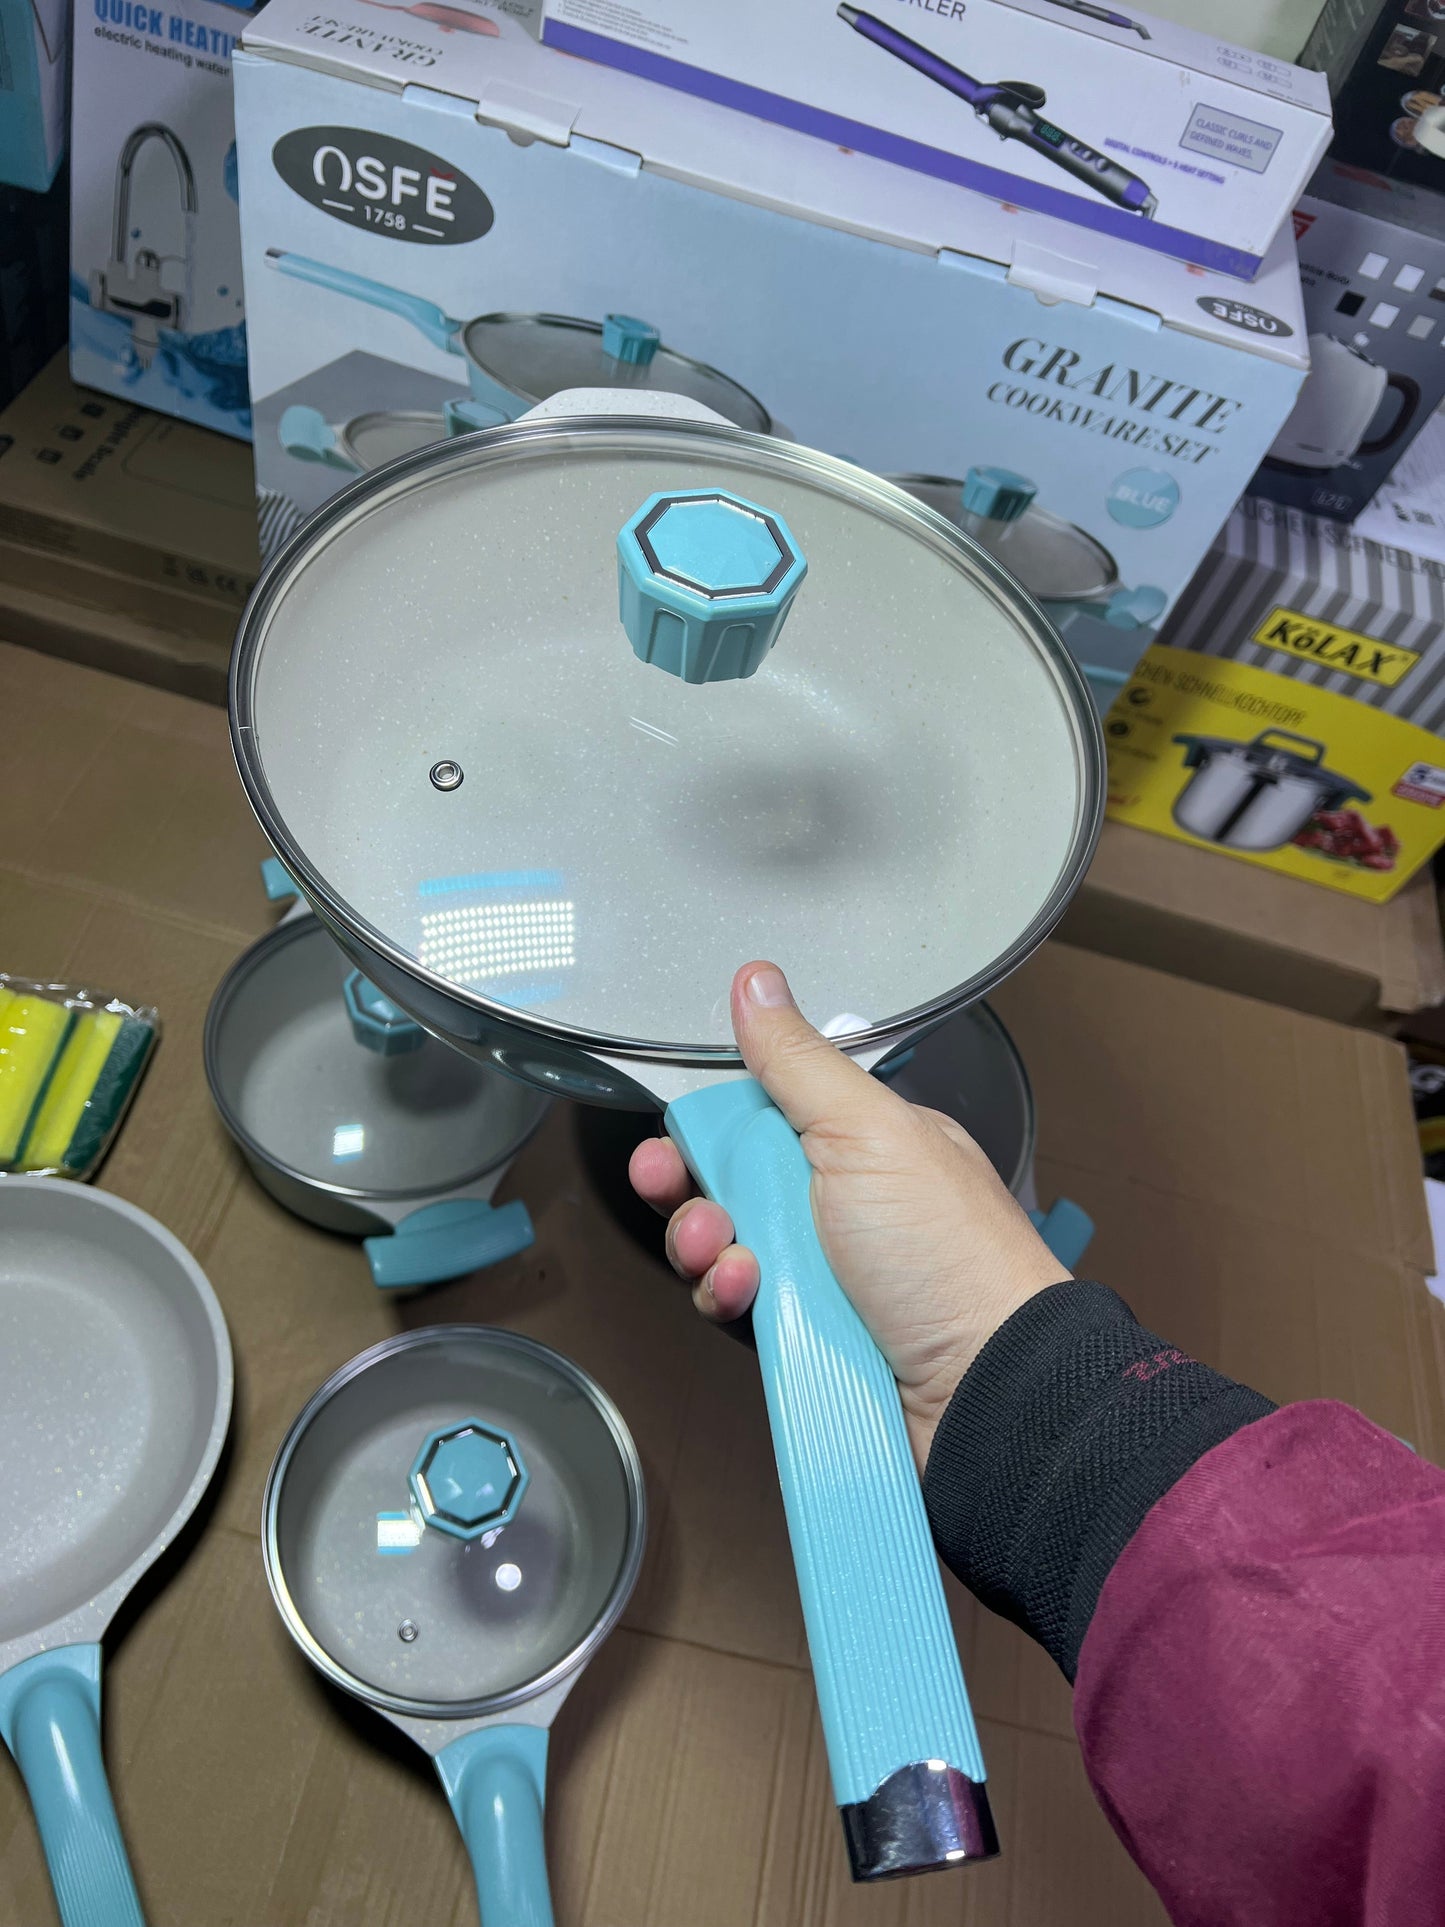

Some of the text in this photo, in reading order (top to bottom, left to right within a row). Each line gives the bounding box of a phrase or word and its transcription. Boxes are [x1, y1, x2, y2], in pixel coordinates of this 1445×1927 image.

[94, 0, 163, 37] QUICK
[94, 25, 142, 49] electric
[145, 40, 192, 68] heating
[296, 23, 436, 67] GRANITE
[1195, 118, 1228, 137] CLASSIC
[1254, 137, 1273, 150] AND
[364, 204, 406, 231] 1758
[1001, 337, 1244, 434] GRANITE
[986, 381, 1220, 464] COOKWARE SET
[1115, 484, 1171, 514] BLUE
